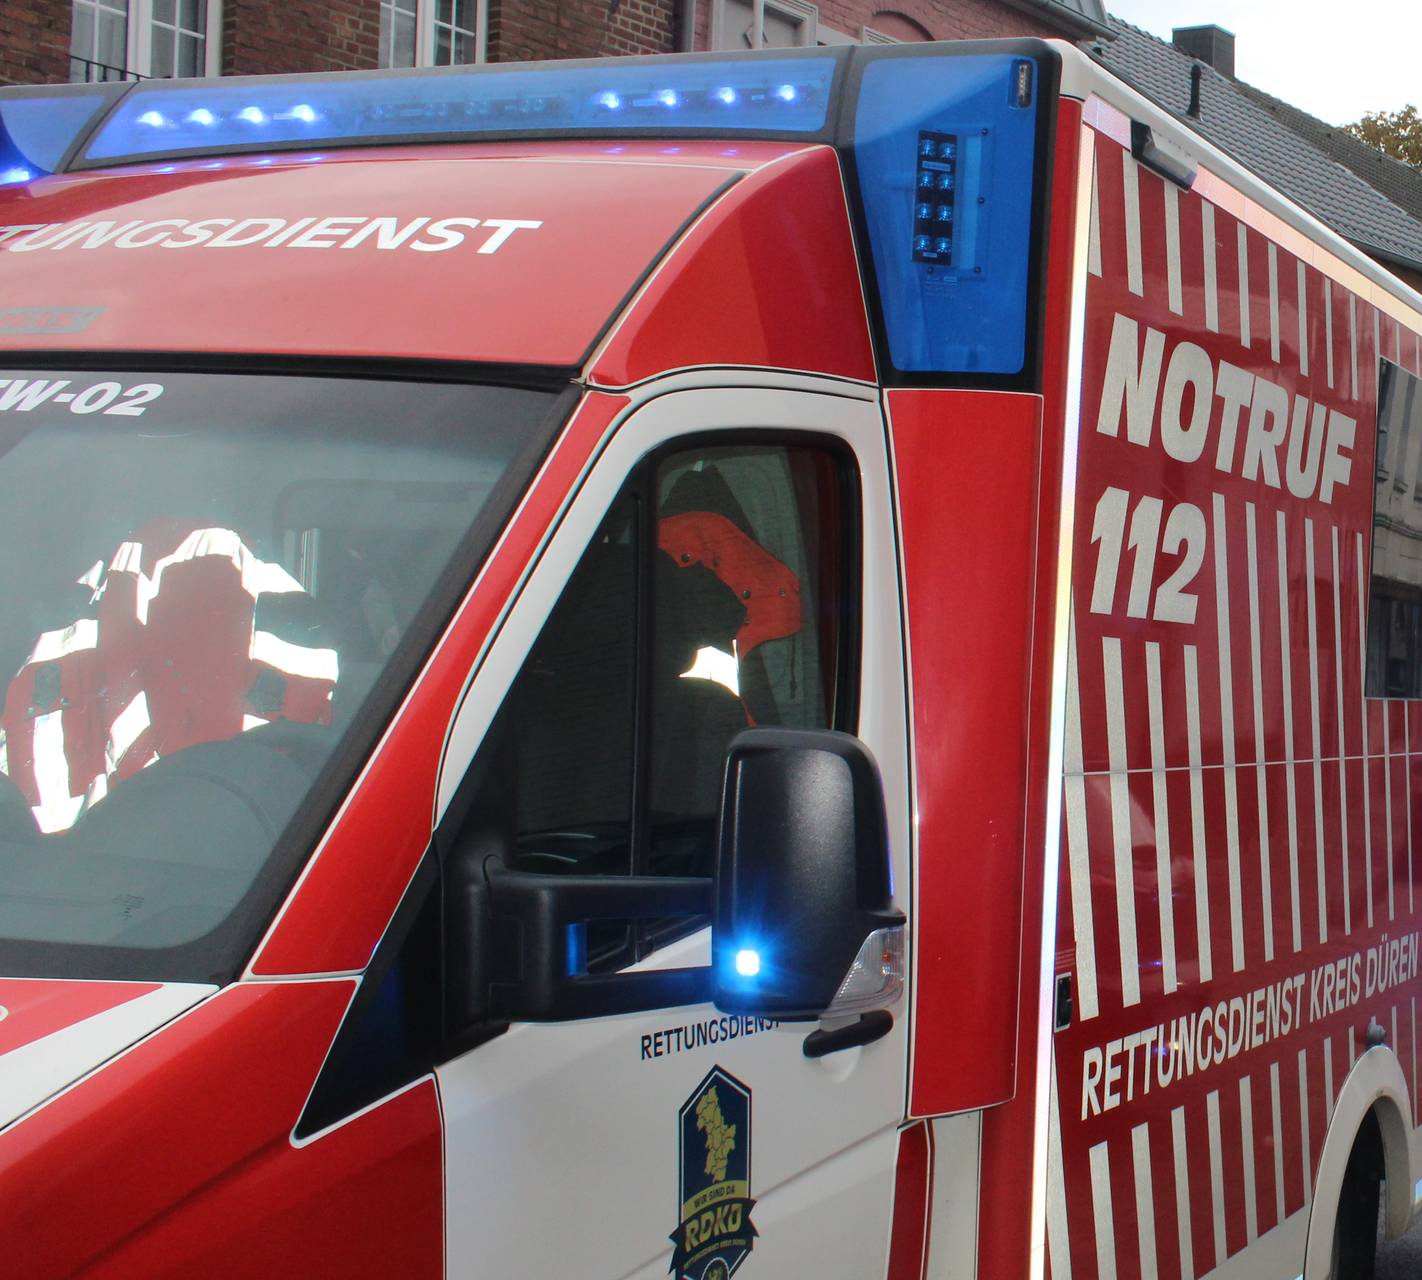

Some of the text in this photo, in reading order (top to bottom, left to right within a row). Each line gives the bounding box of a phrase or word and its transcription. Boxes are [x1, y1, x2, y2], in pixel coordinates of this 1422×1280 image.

[1096, 311, 1357, 505] NOTRUF
[1090, 486, 1207, 625] 112
[1081, 932, 1420, 1121] RETTUNGSDIENST KREIS DÜREN
